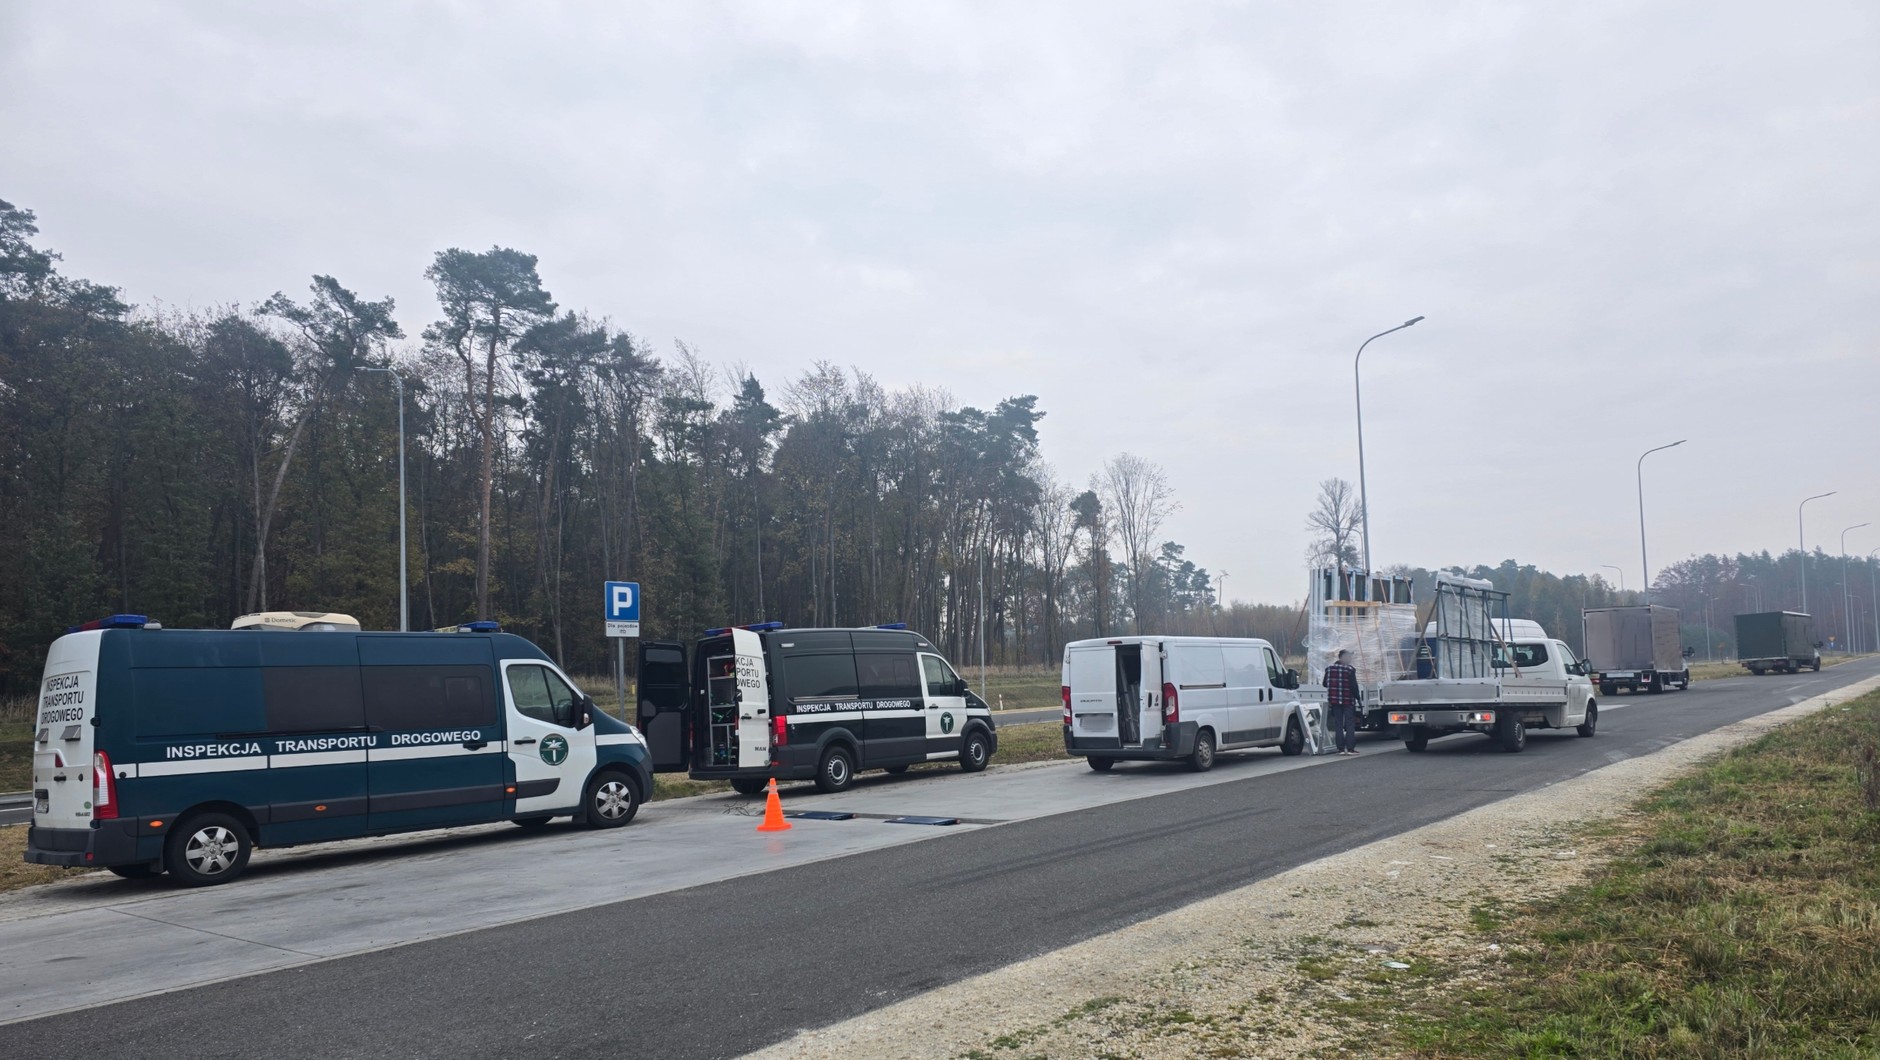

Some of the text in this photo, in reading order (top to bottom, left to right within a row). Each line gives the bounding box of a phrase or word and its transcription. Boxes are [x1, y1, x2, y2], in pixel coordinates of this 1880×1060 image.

[613, 586, 632, 616] P
[46, 676, 79, 692] INSPEKCJA
[43, 691, 84, 708] TRANSPORTU
[796, 700, 911, 713] INSPEKCJA TRANSPORTU DROGOWEGO
[41, 708, 84, 725] DROGOWEGO
[166, 730, 481, 759] INSPEKCJA TRANSPORTU DROGOWEGO
